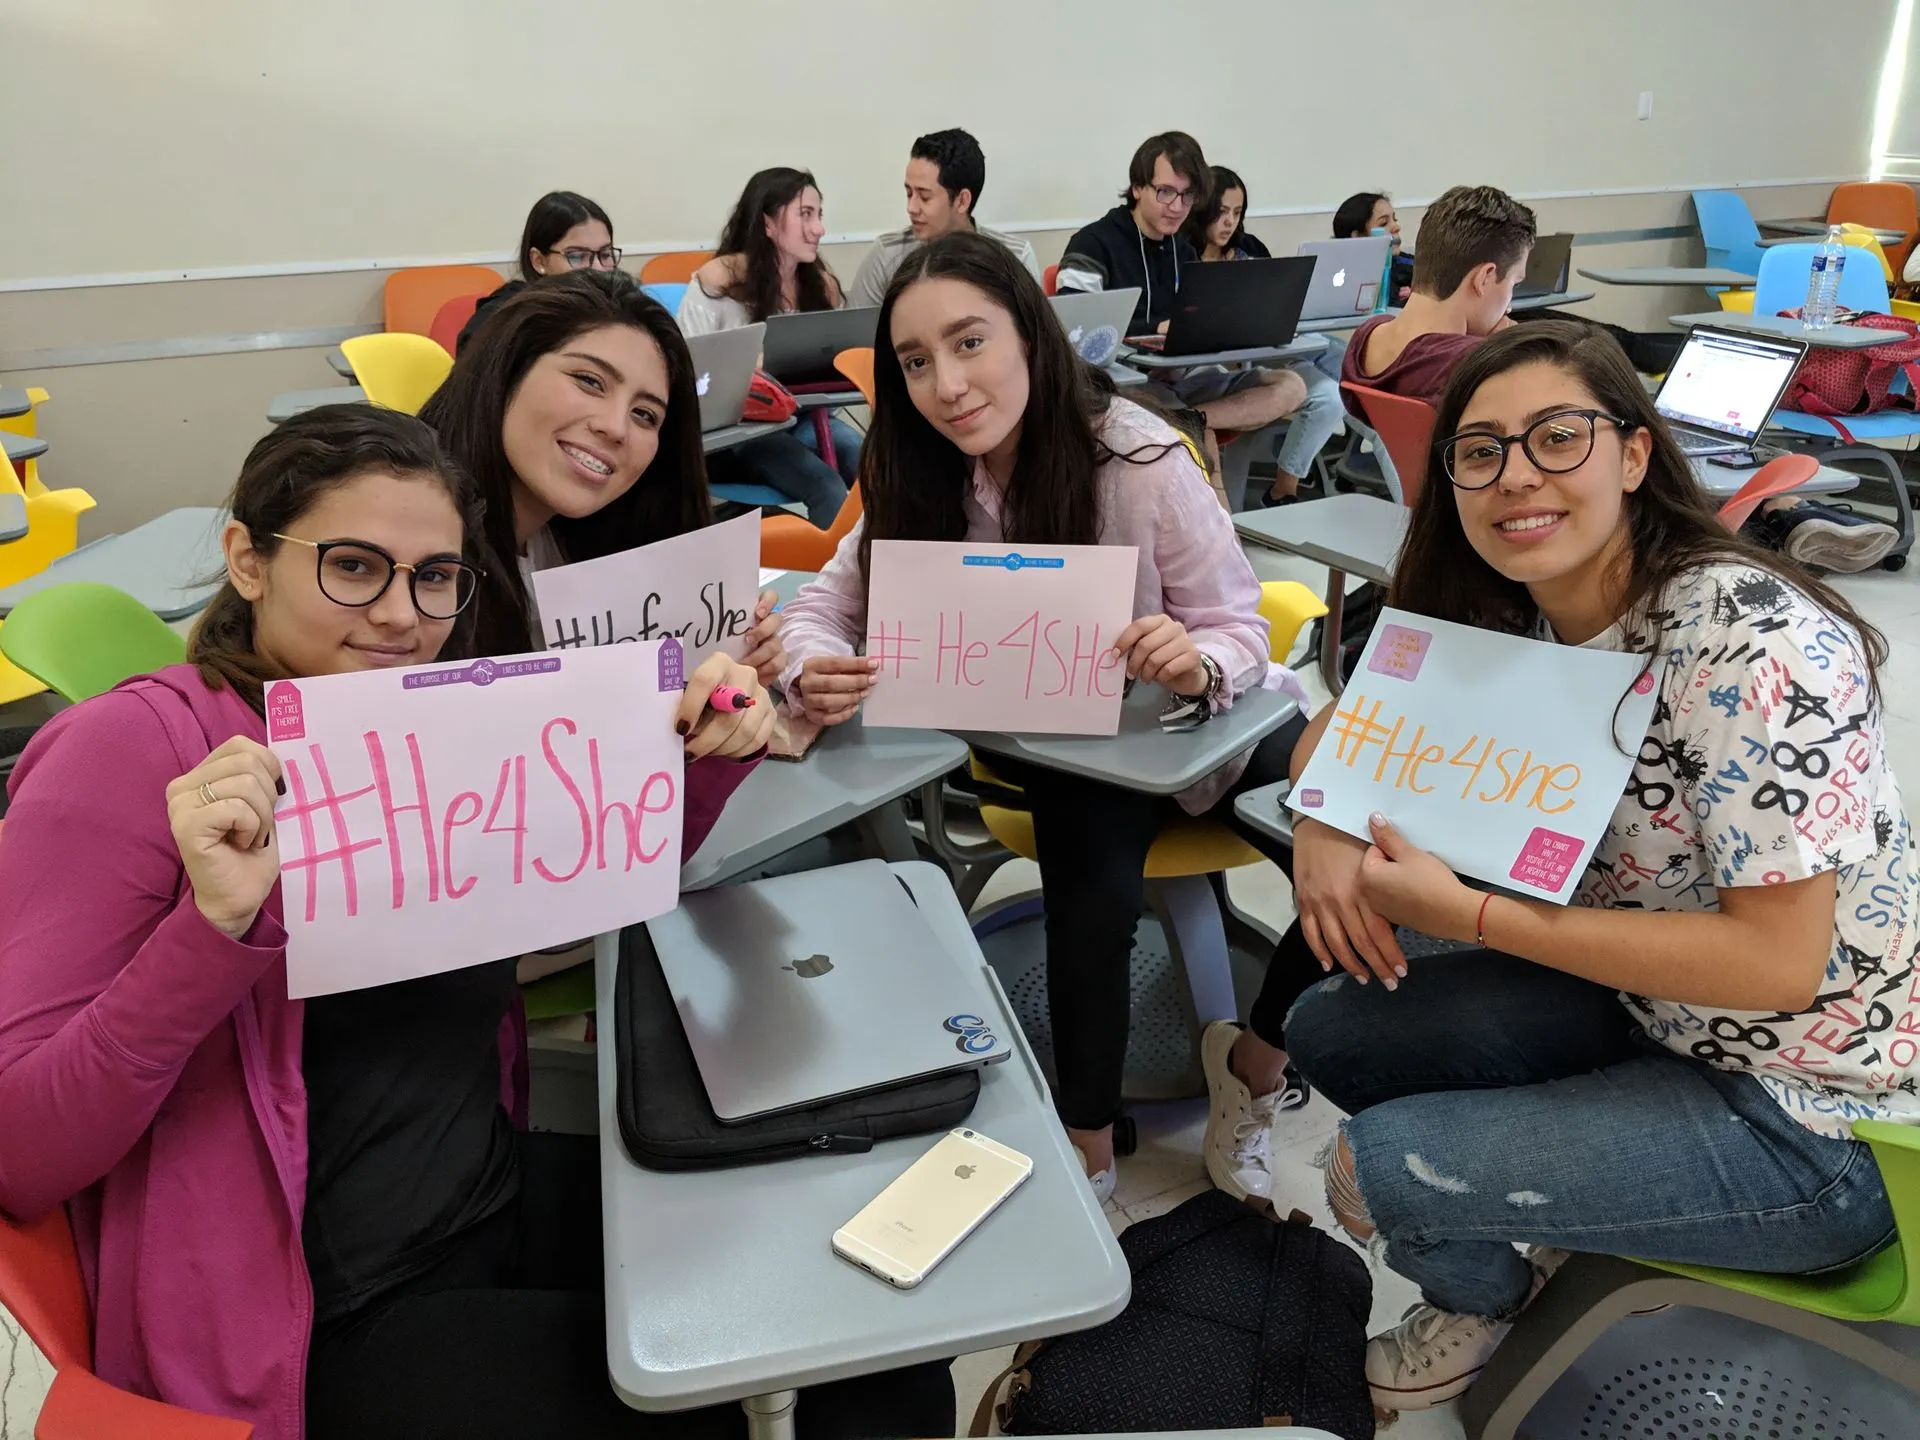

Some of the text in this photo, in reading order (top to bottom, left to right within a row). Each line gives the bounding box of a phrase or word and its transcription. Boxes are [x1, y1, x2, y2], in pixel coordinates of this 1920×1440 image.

[524, 664, 533, 672] TO
[408, 671, 462, 686] THE PURPOSE OF OUR
[274, 717, 676, 923] #He4She
